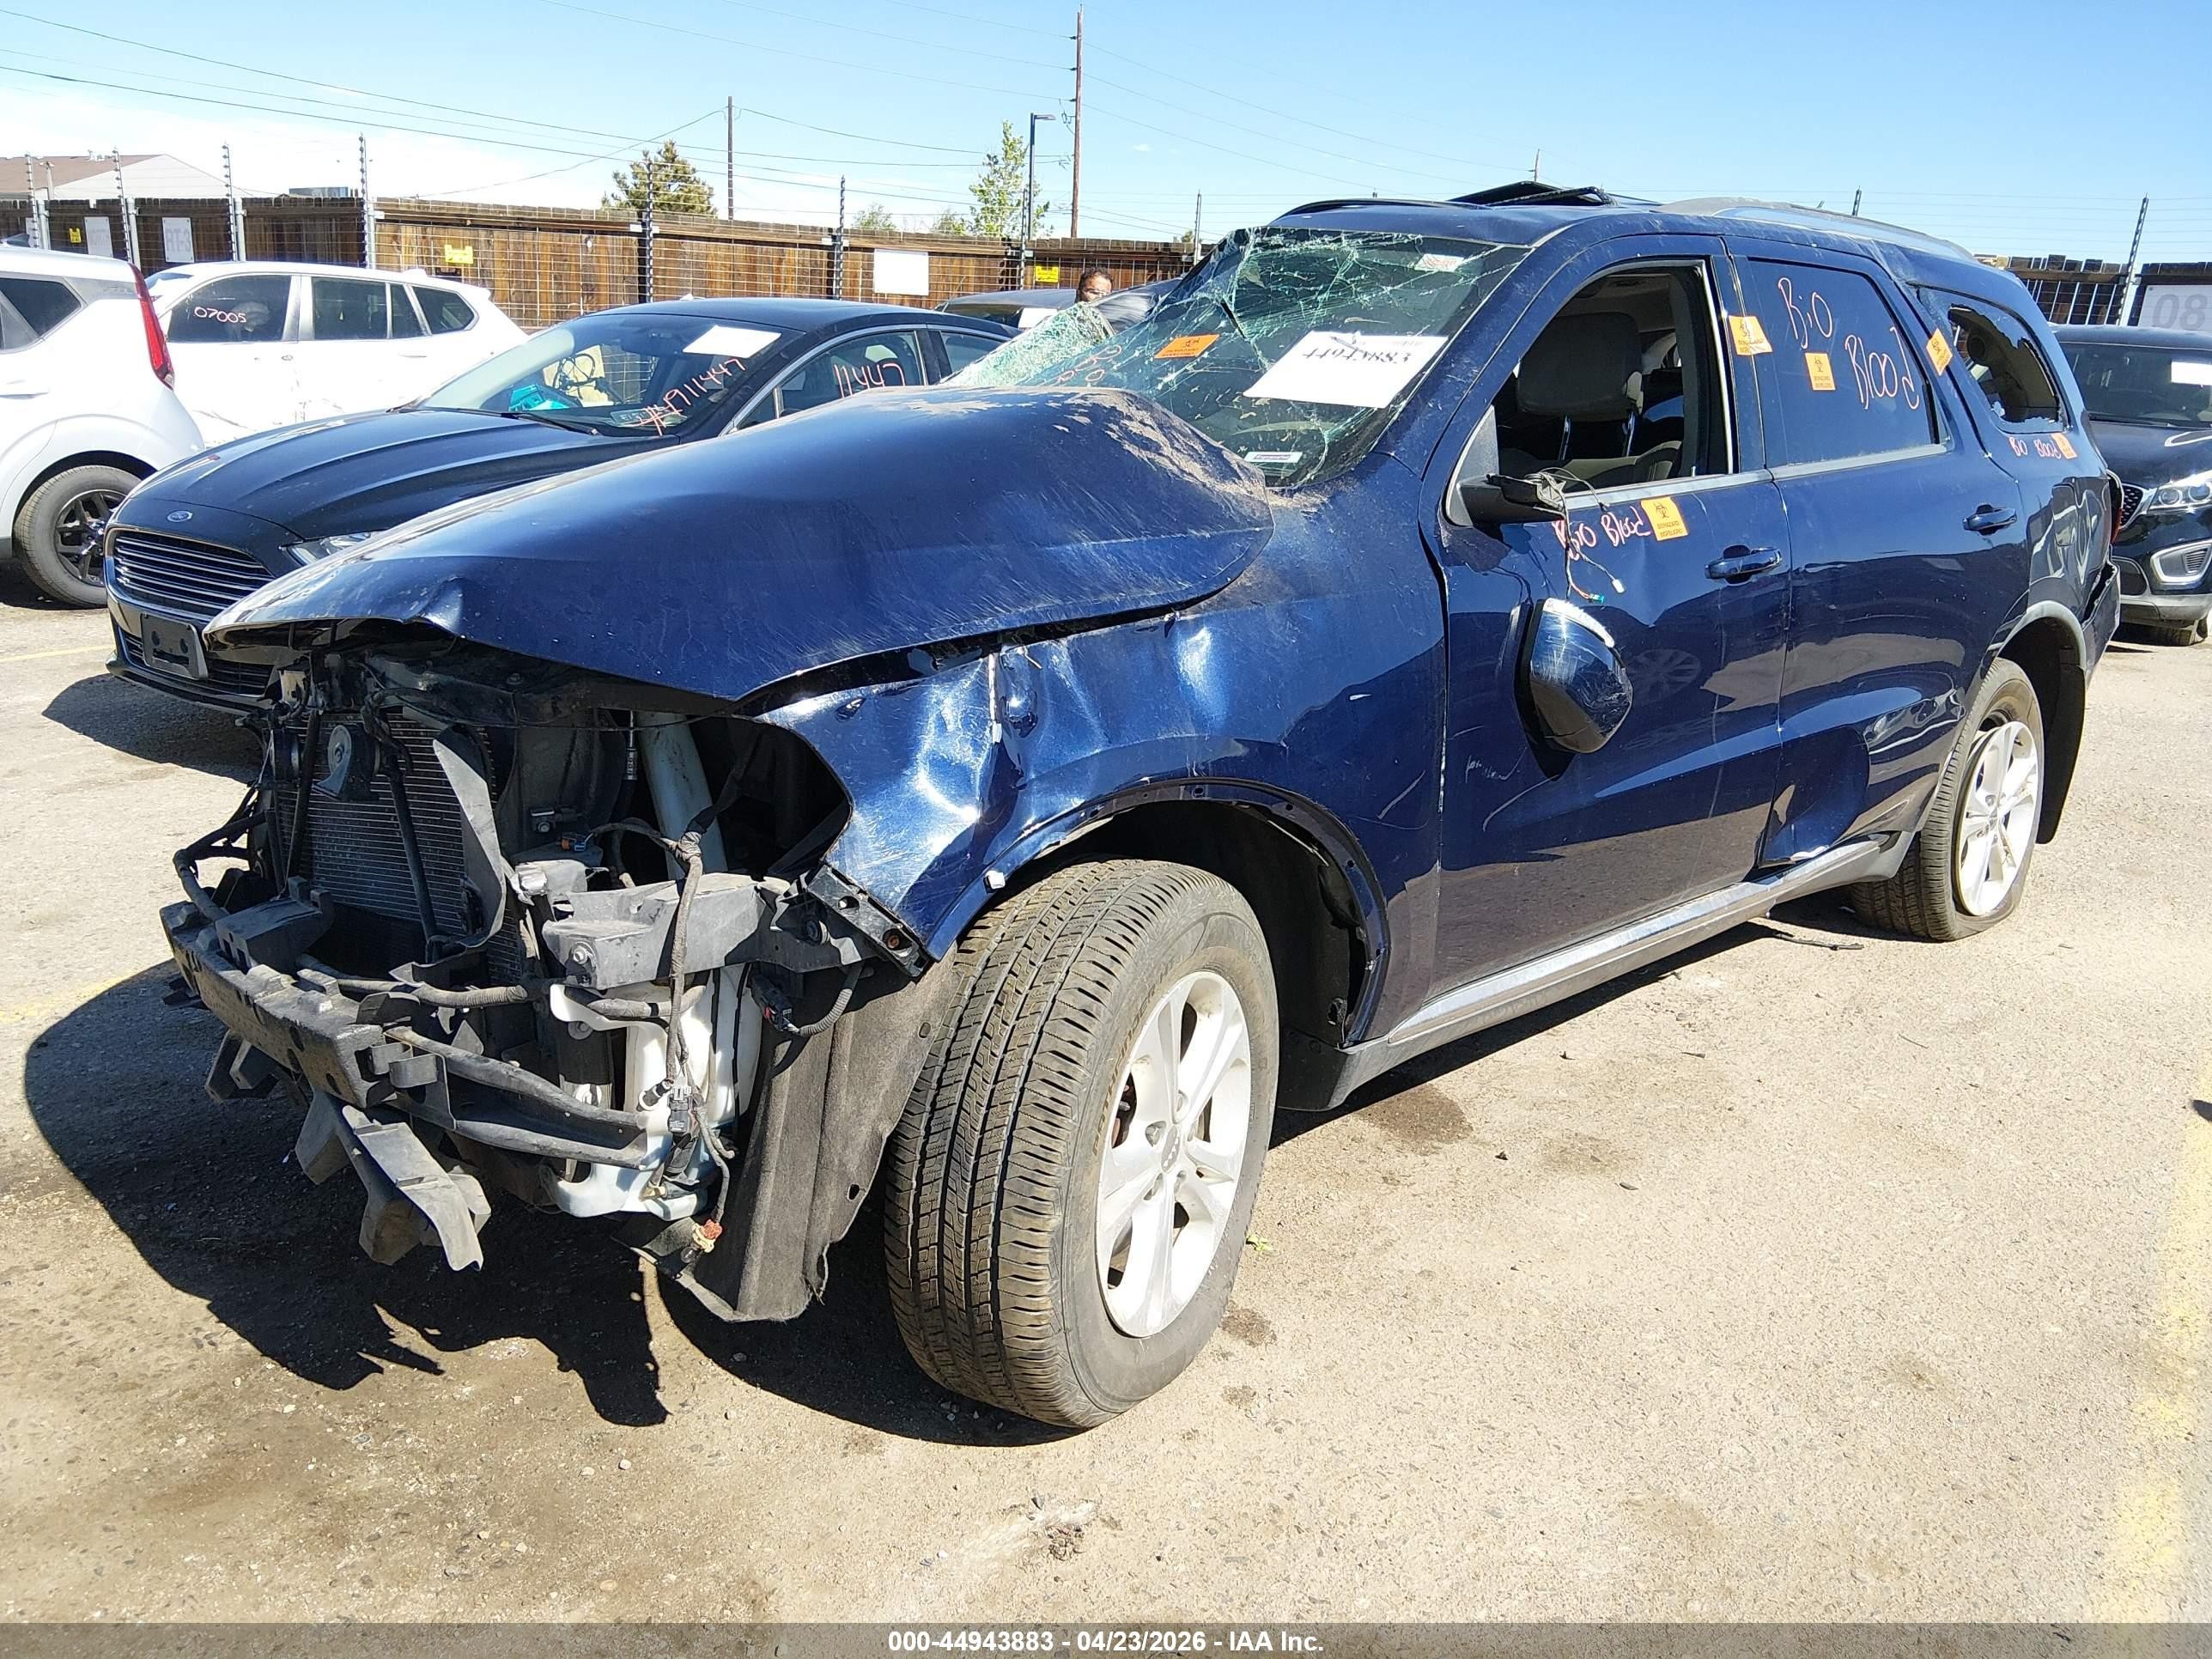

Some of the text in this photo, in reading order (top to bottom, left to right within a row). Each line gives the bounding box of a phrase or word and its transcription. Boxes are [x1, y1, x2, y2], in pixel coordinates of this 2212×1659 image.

[194, 306, 247, 323] 07005
[2152, 293, 2208, 331] 08
[834, 362, 907, 398] 11447
[1844, 326, 1920, 411] Blood
[1601, 506, 1652, 548] Blood
